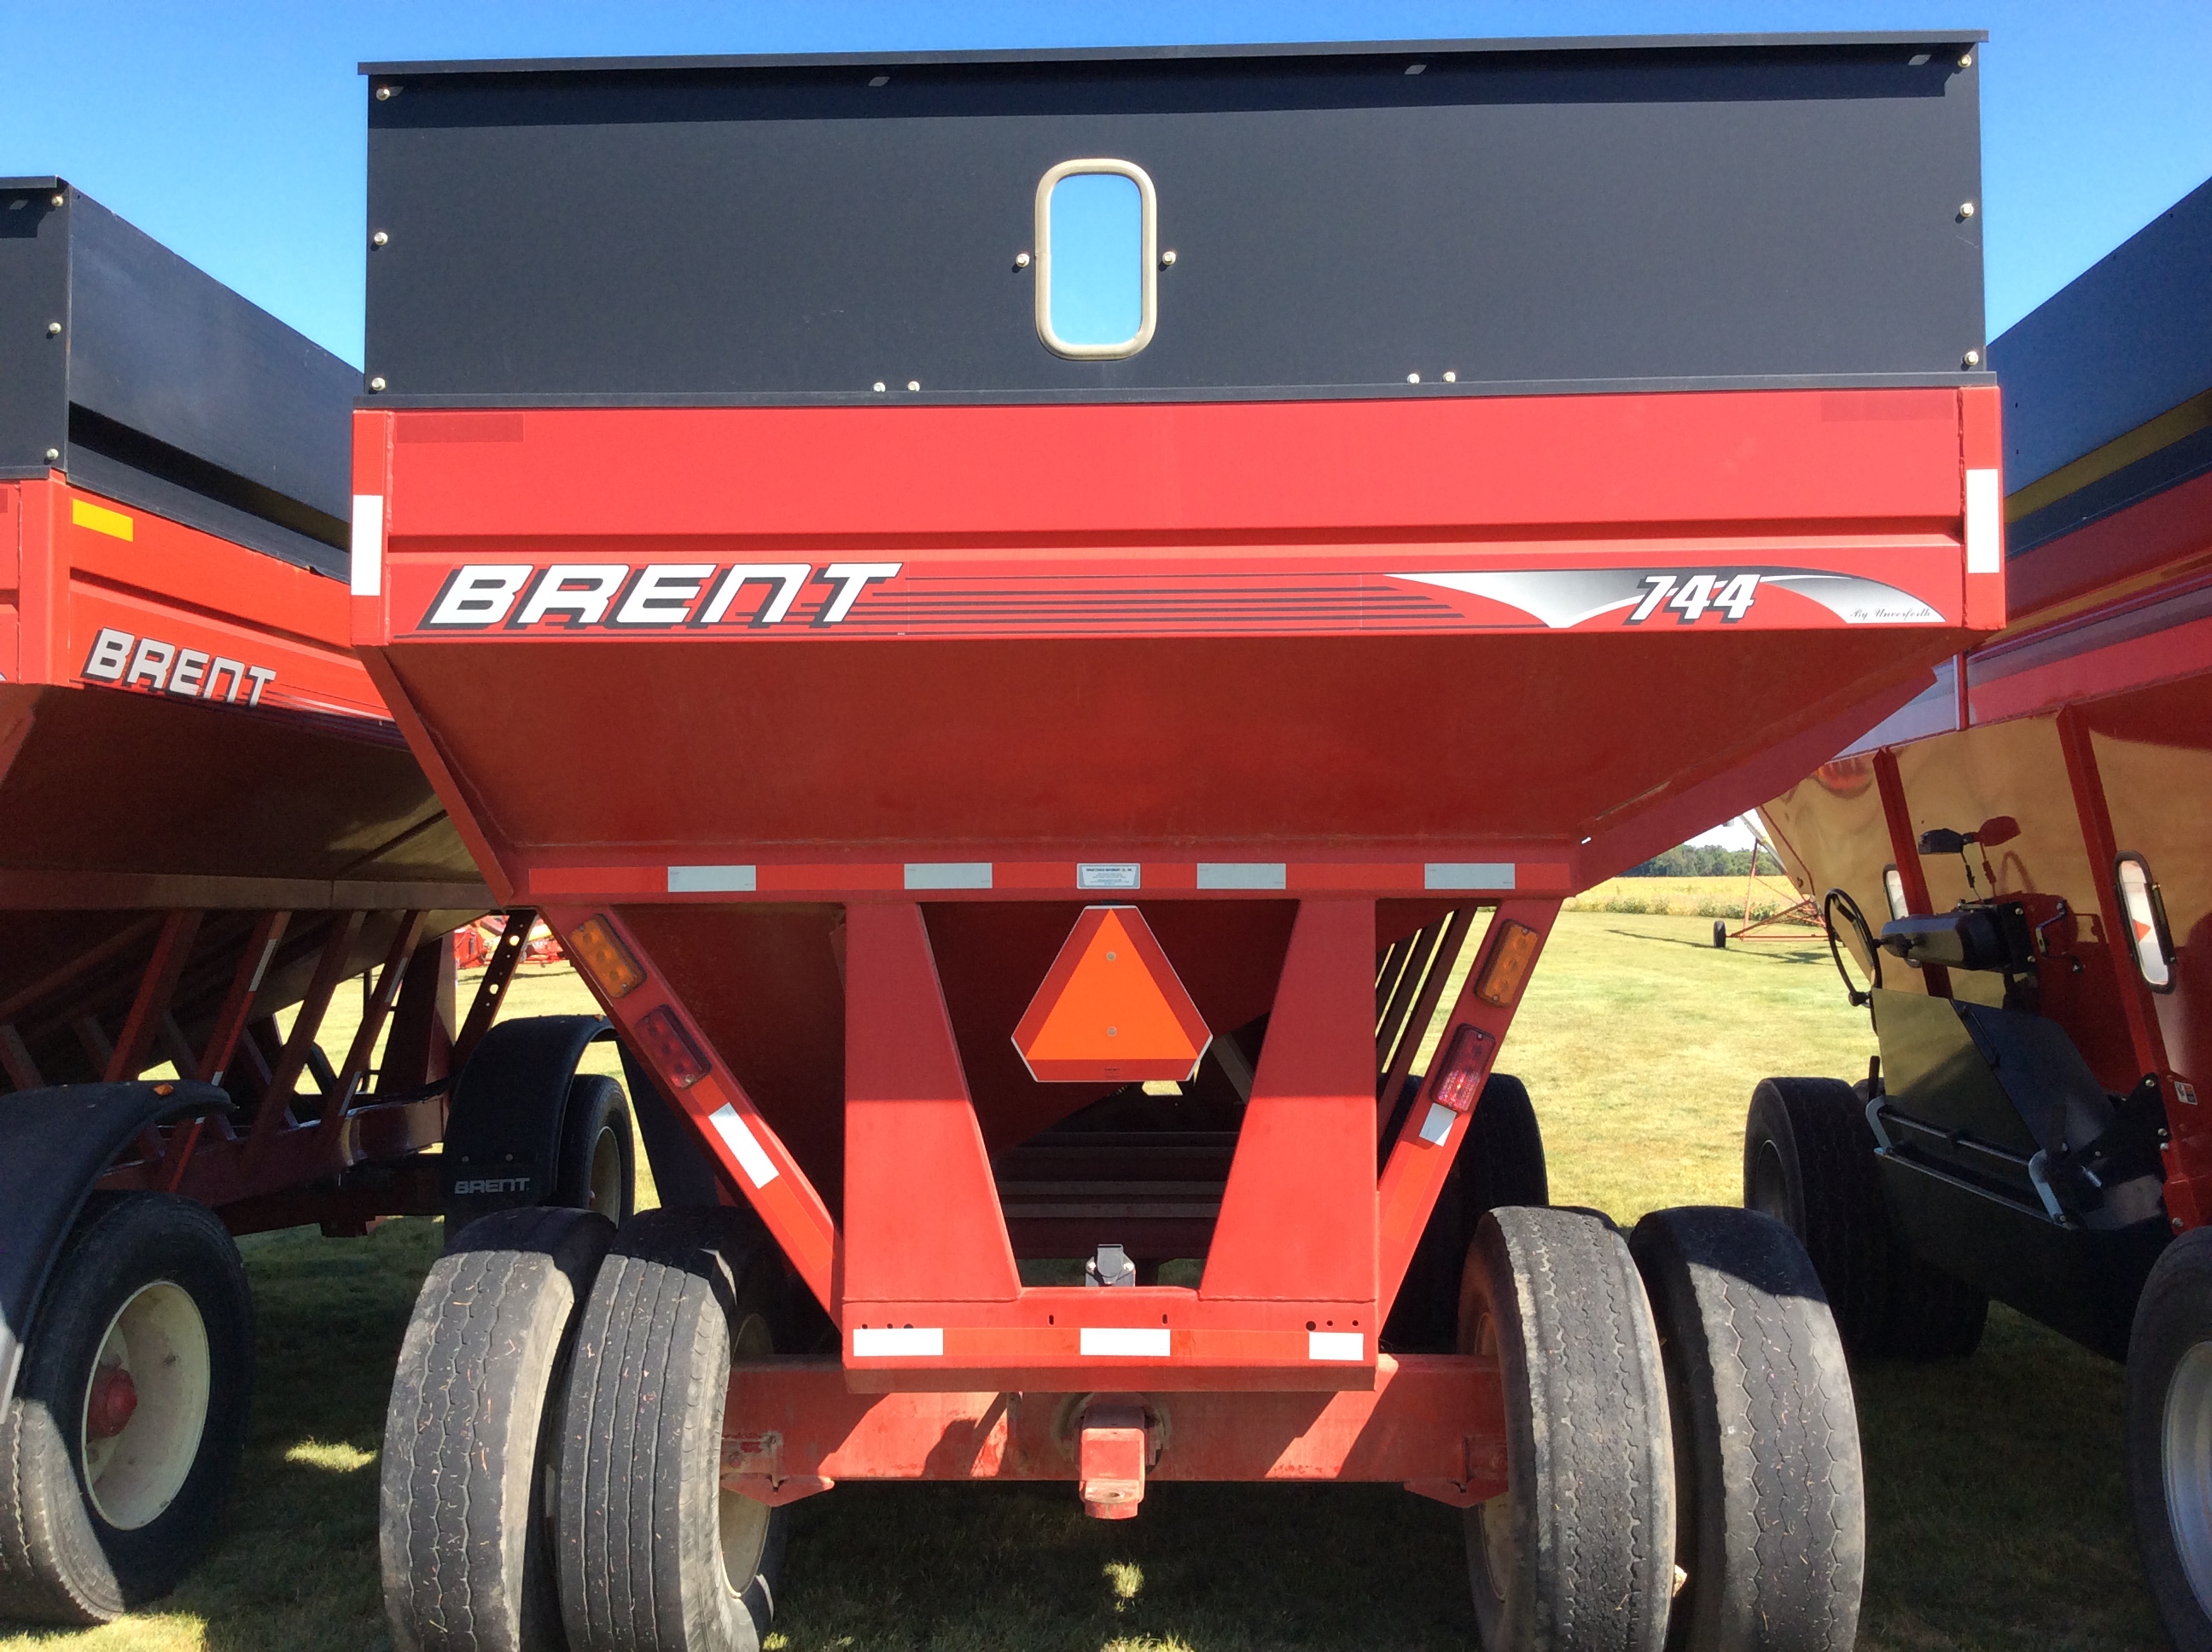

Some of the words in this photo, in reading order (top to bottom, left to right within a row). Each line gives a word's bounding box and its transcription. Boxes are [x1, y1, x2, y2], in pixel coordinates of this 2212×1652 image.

[420, 563, 903, 629] BRENT
[1624, 573, 1761, 624] 744
[1850, 608, 1869, 621] By
[81, 626, 276, 707] BRENT
[454, 1178, 530, 1195] BRENT
